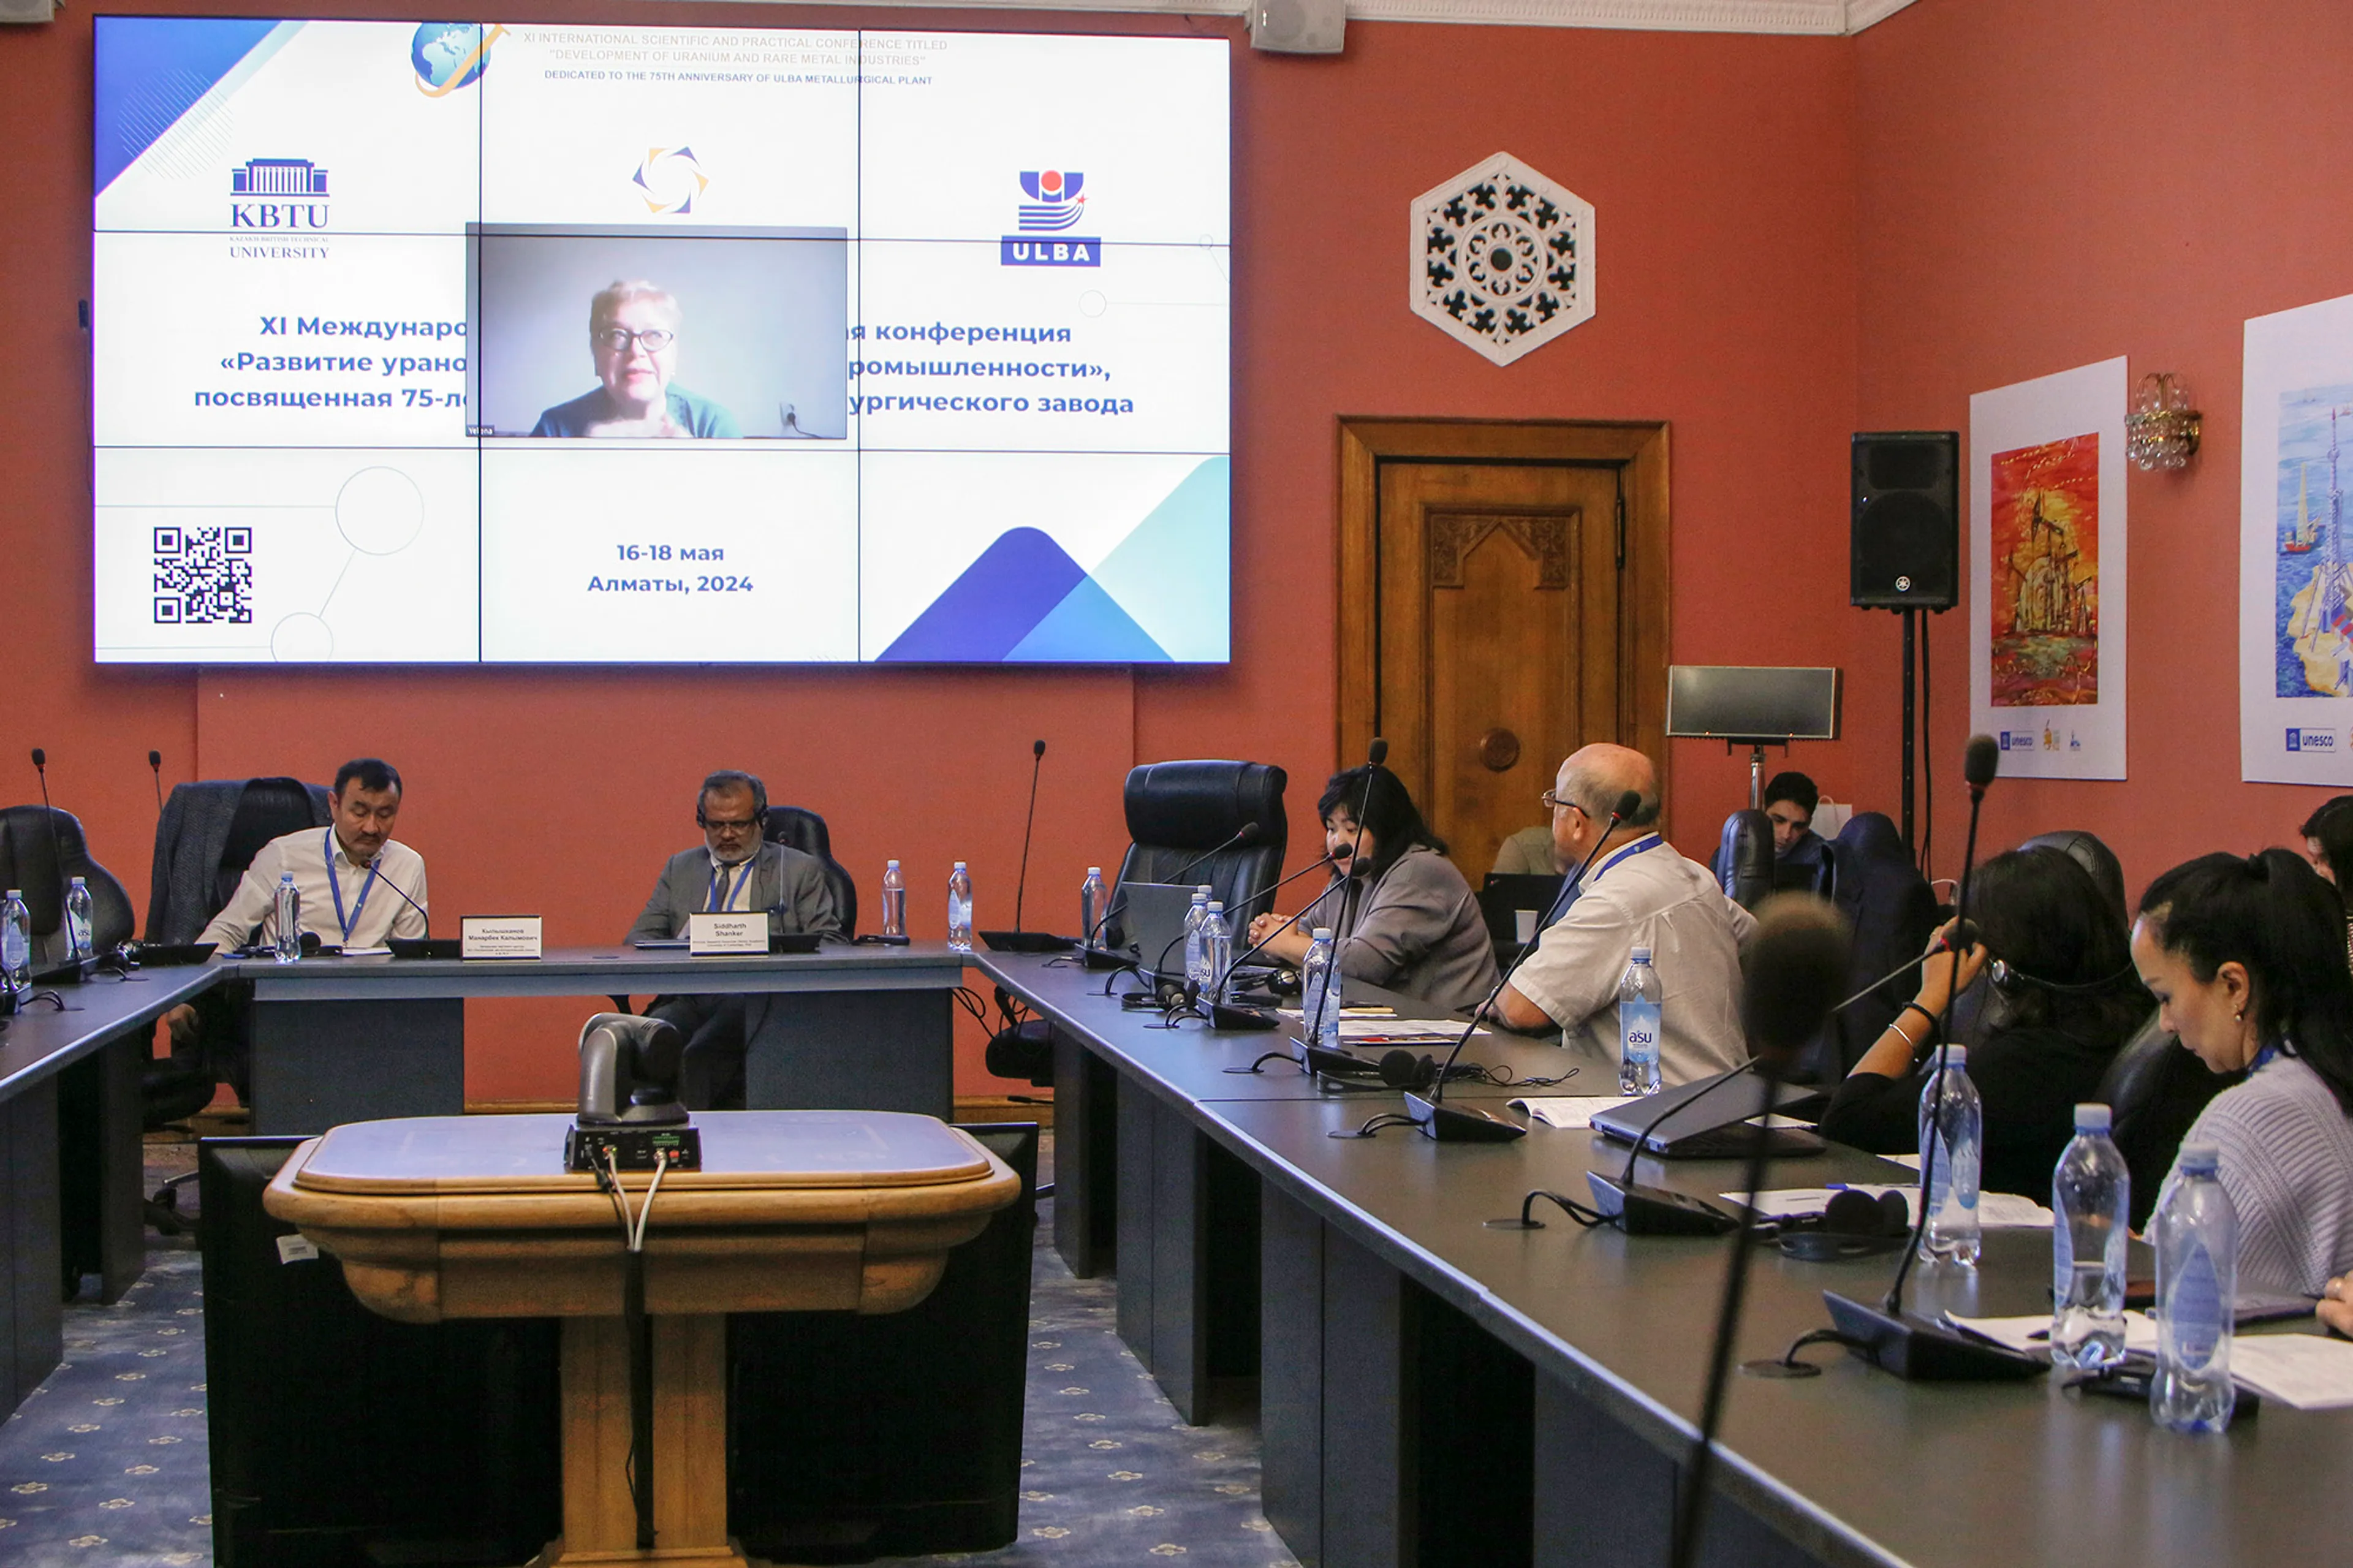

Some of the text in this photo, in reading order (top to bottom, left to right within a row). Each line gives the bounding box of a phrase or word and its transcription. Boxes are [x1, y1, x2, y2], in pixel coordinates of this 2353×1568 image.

[524, 33, 947, 50] XI INTERNATIONAL SCIENTIFIC AND PRACTICAL CONFERENCE TITLED
[653, 51, 669, 61] OF
[673, 51, 730, 62] URANIUM
[733, 53, 759, 62] AND
[763, 53, 797, 64] RARE
[801, 55, 841, 64] METAL
[545, 70, 932, 85] DEDICATED TO THE 75TH ANNIVERSARY OF ULBA METALLURGICAL PLANT
[230, 203, 330, 229] KBTU
[230, 246, 330, 259] UNIVERSITY
[1012, 242, 1091, 261] ULBA
[260, 316, 468, 341] XI Междунаро
[876, 322, 1071, 346] конференция
[221, 352, 467, 376] «Развитие урано
[849, 360, 1111, 381] ромышленности»,
[195, 392, 393, 409] посвященная
[849, 396, 1134, 416] ургического завода
[616, 544, 724, 561] 16-18 мая
[587, 576, 754, 595] Алматы, 2024
[2012, 737, 2034, 746] unesco
[2302, 735, 2334, 746] unesco
[1629, 1031, 1652, 1043] asu
